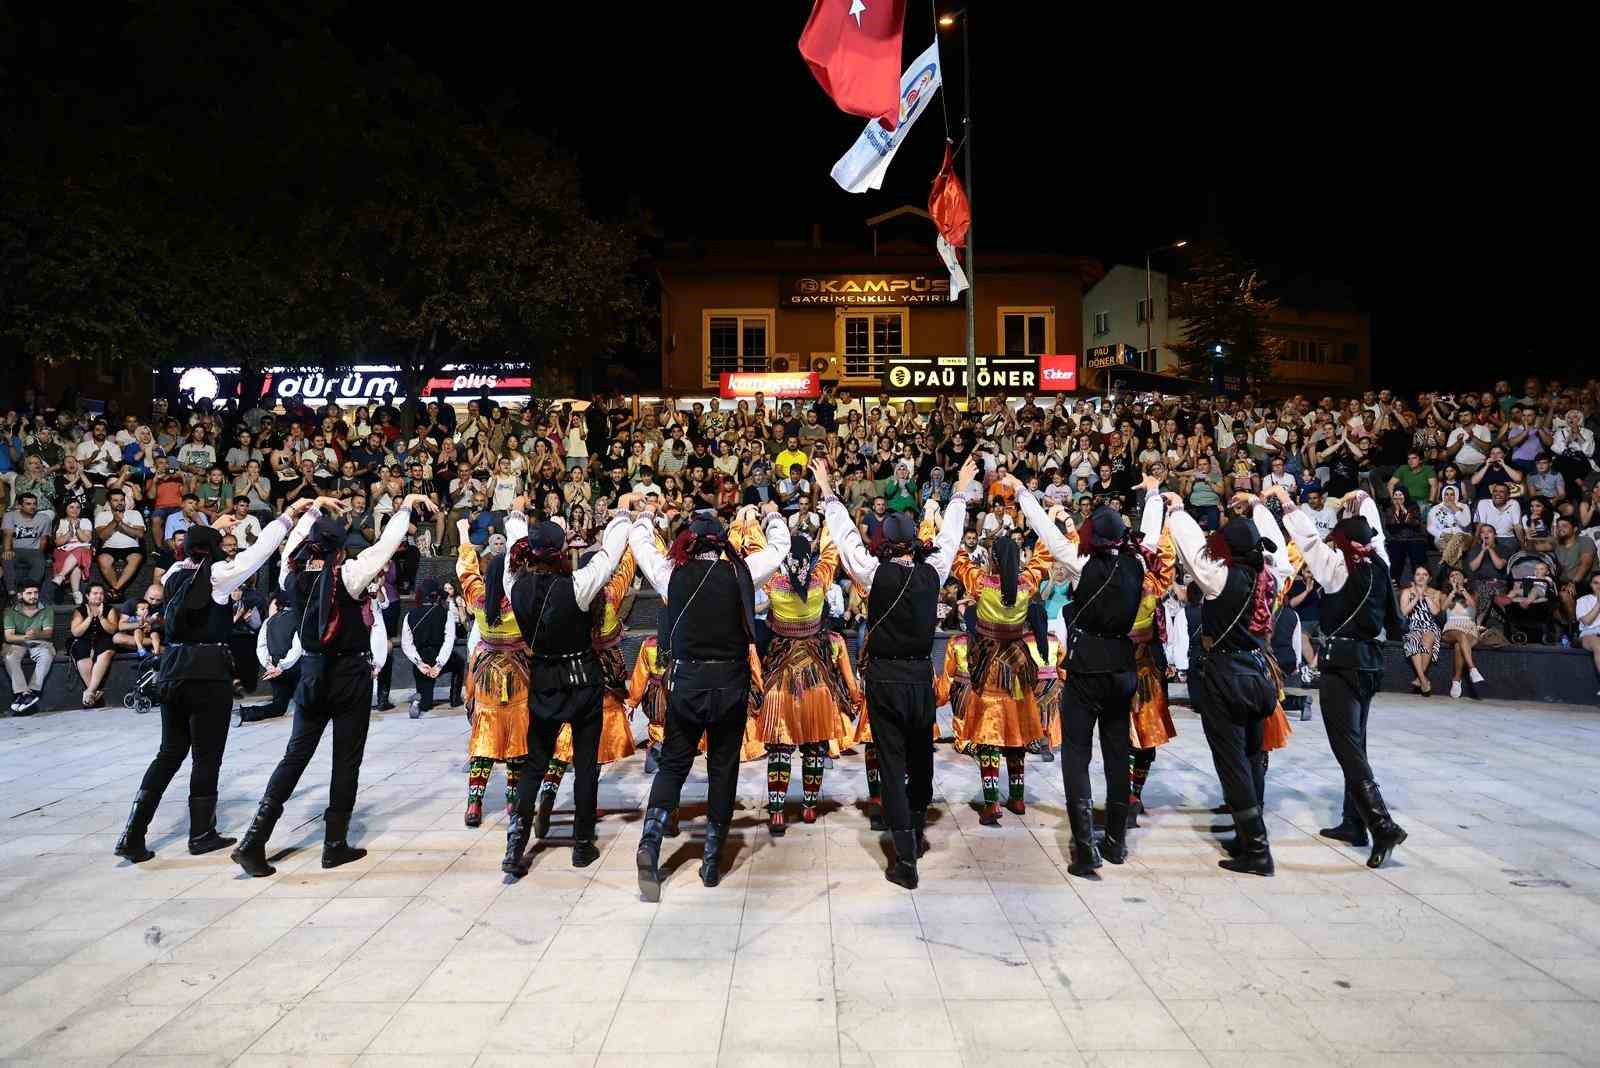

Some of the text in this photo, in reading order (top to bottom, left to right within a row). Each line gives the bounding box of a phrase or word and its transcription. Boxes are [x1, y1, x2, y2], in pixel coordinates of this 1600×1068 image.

[820, 277, 949, 292] KAMPÜS
[792, 293, 950, 303] GAYRİMENKUL YATIRI
[278, 372, 398, 397] dürüm
[453, 373, 497, 391] plus
[914, 368, 955, 386] PAÜ
